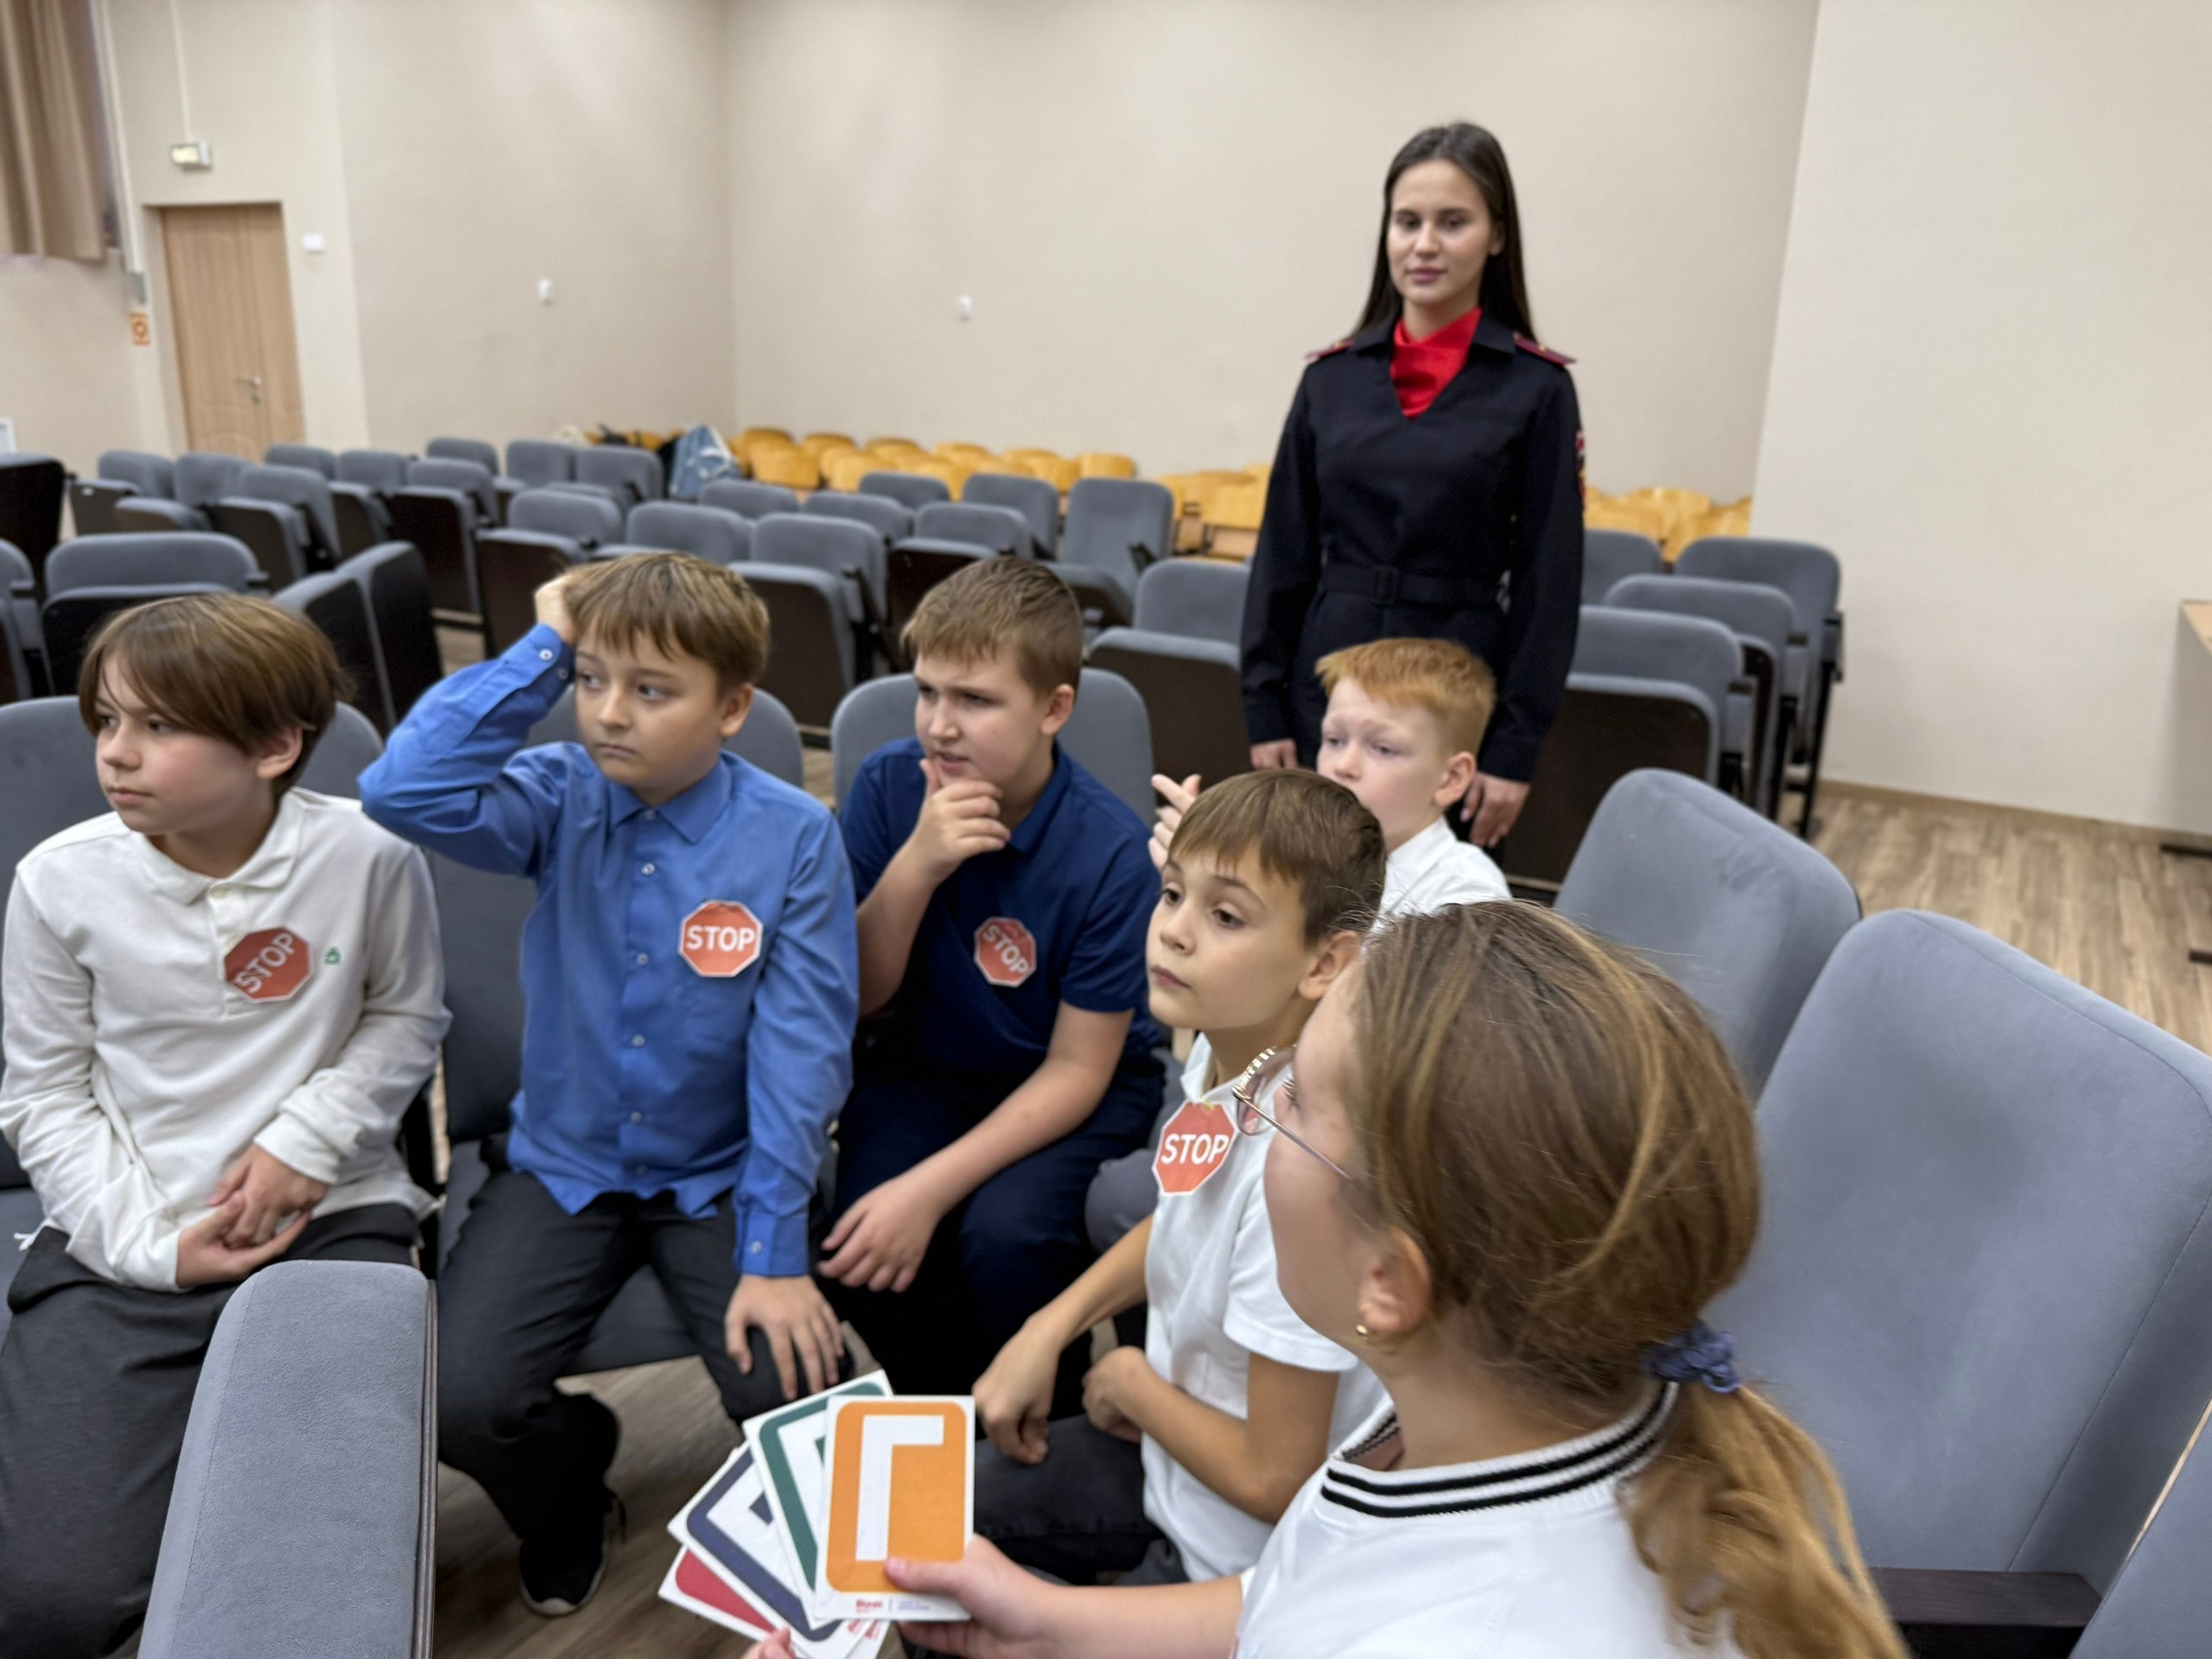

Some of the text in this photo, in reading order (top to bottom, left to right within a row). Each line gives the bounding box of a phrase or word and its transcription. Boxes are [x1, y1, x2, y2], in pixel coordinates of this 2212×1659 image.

[685, 925, 755, 952] STOP
[983, 925, 1029, 973] STOP
[234, 932, 295, 993] STOP
[1160, 1133, 1230, 1165] STOP
